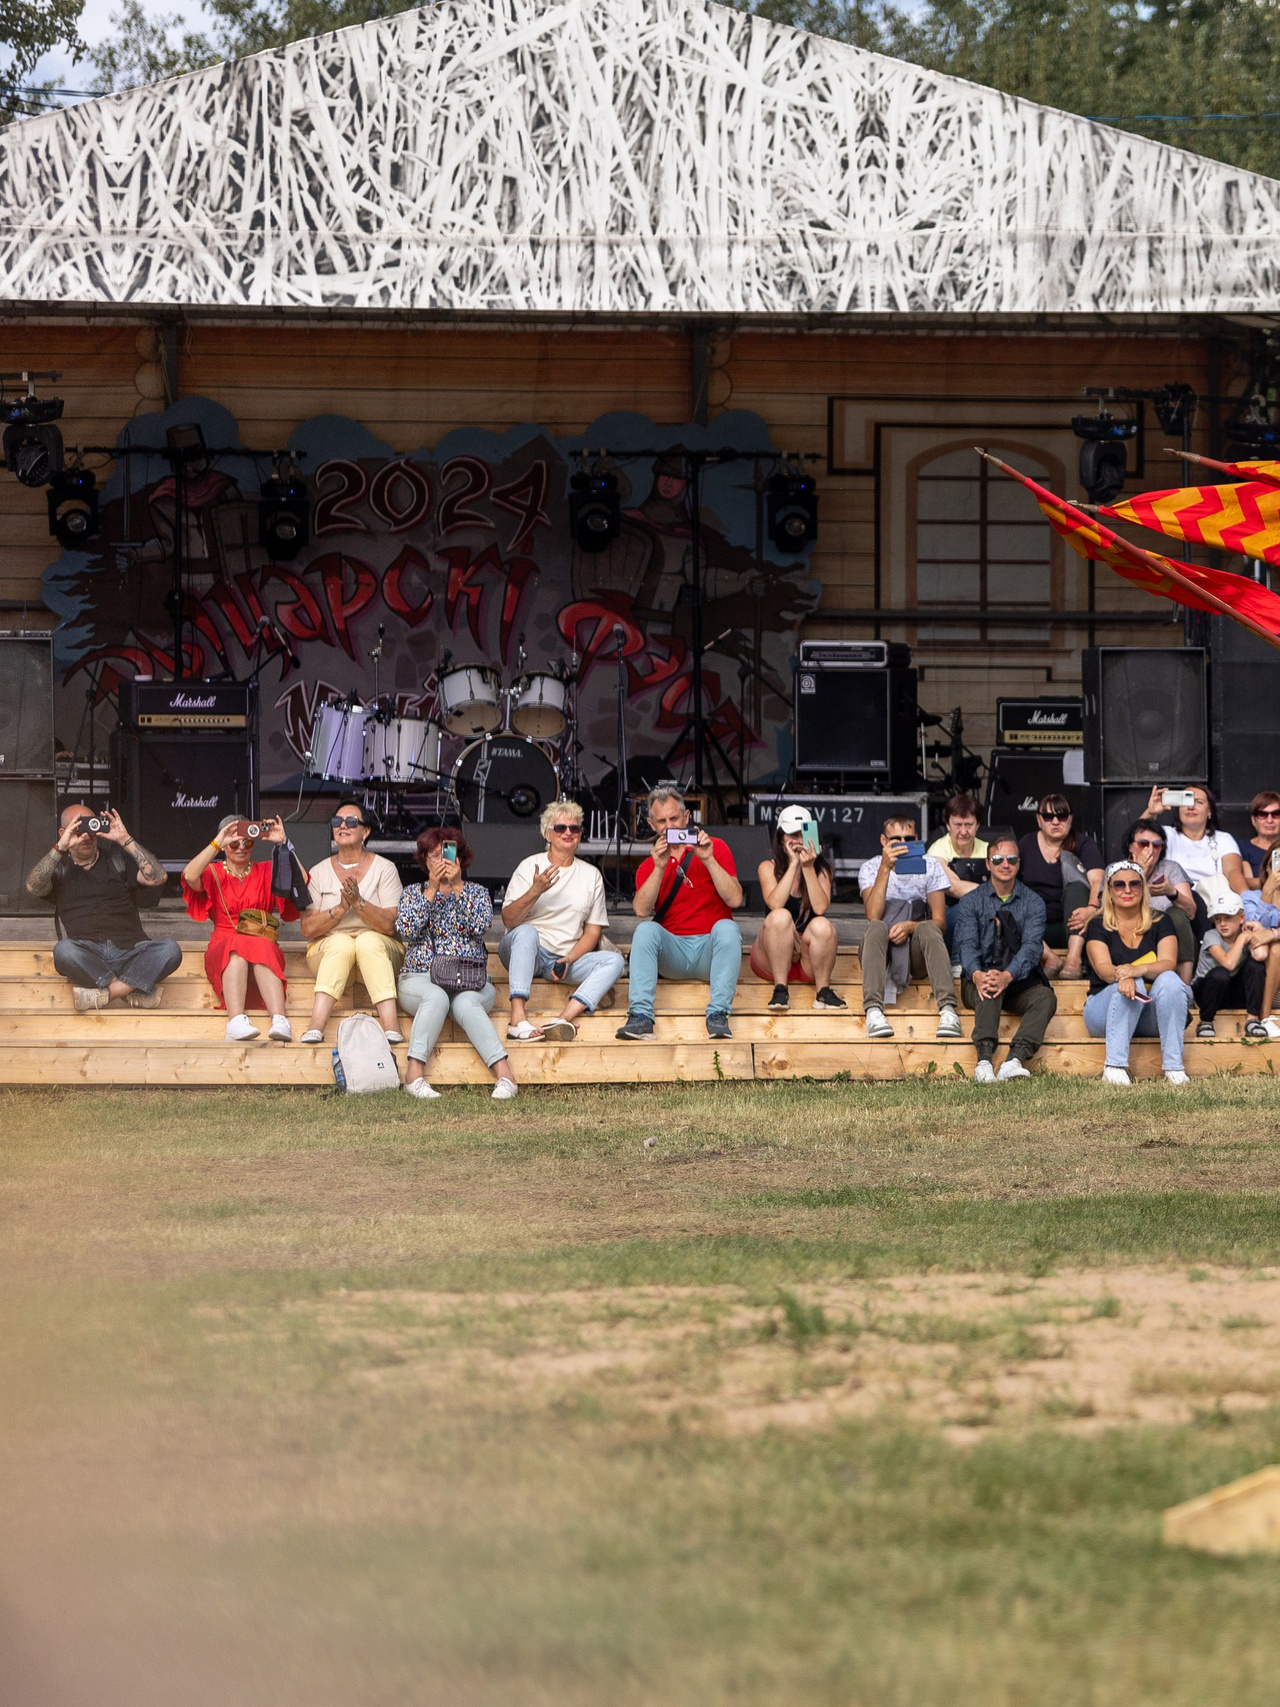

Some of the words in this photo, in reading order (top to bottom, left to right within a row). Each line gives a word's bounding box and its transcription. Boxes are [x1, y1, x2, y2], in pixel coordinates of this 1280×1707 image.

[314, 456, 551, 551] 2024
[170, 693, 216, 708] Marshall
[1027, 710, 1068, 726] Marshall
[497, 747, 521, 758] TAMA
[171, 792, 218, 807] Marshall
